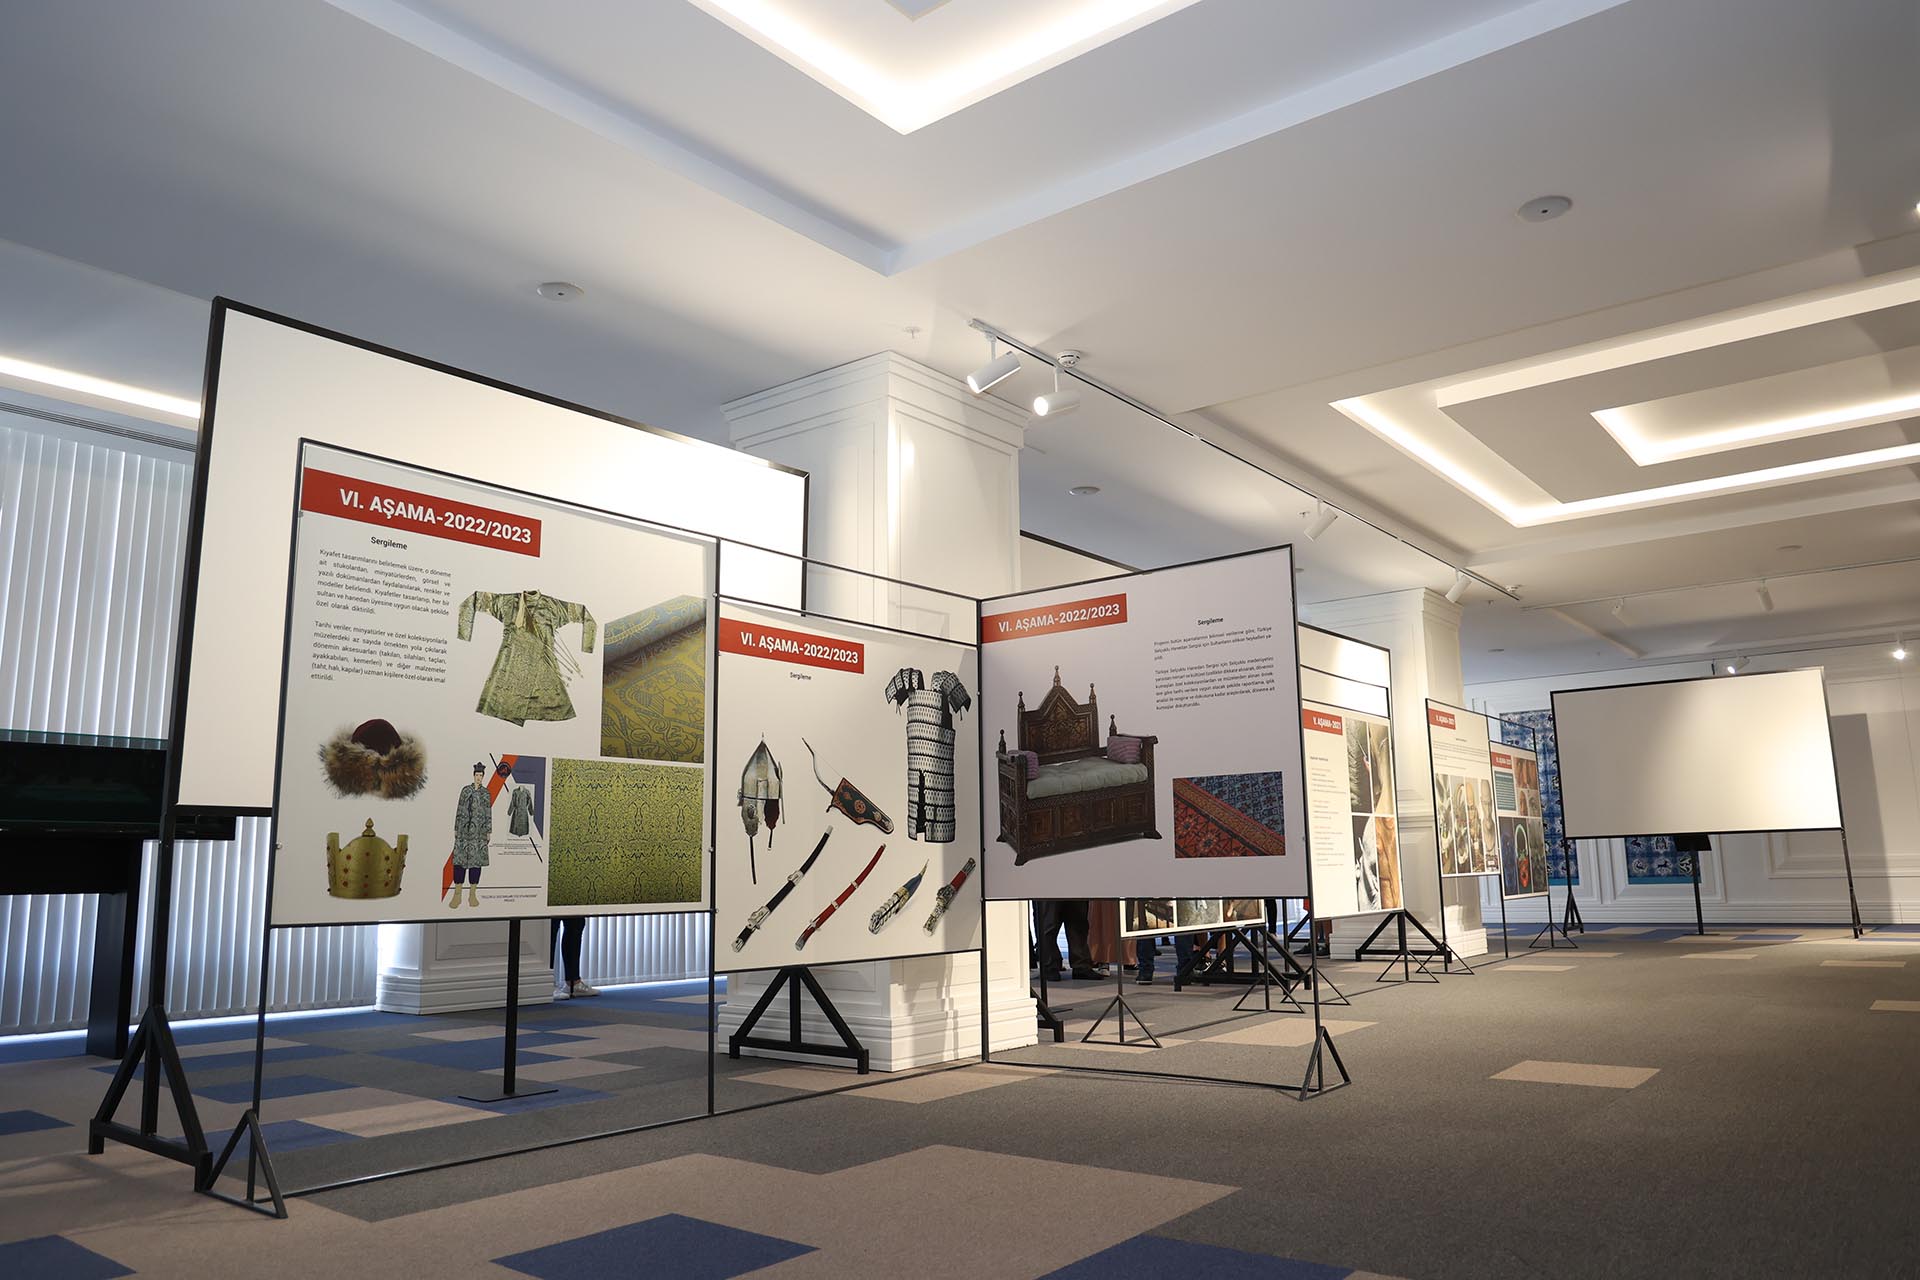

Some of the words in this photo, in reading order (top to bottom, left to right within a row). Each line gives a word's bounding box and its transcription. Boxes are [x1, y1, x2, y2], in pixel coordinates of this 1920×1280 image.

[340, 488, 364, 509] VI.
[370, 496, 532, 544] AŞAMA-2022/2023
[370, 536, 408, 550] Sergileme
[998, 621, 1012, 633] VI.
[1015, 603, 1120, 632] AŞAMA-2022/2023
[1198, 617, 1224, 626] Sergileme
[740, 632, 756, 646] VI.
[759, 636, 859, 664] AŞAMA-2022/2023
[790, 672, 811, 681] Sergileme
